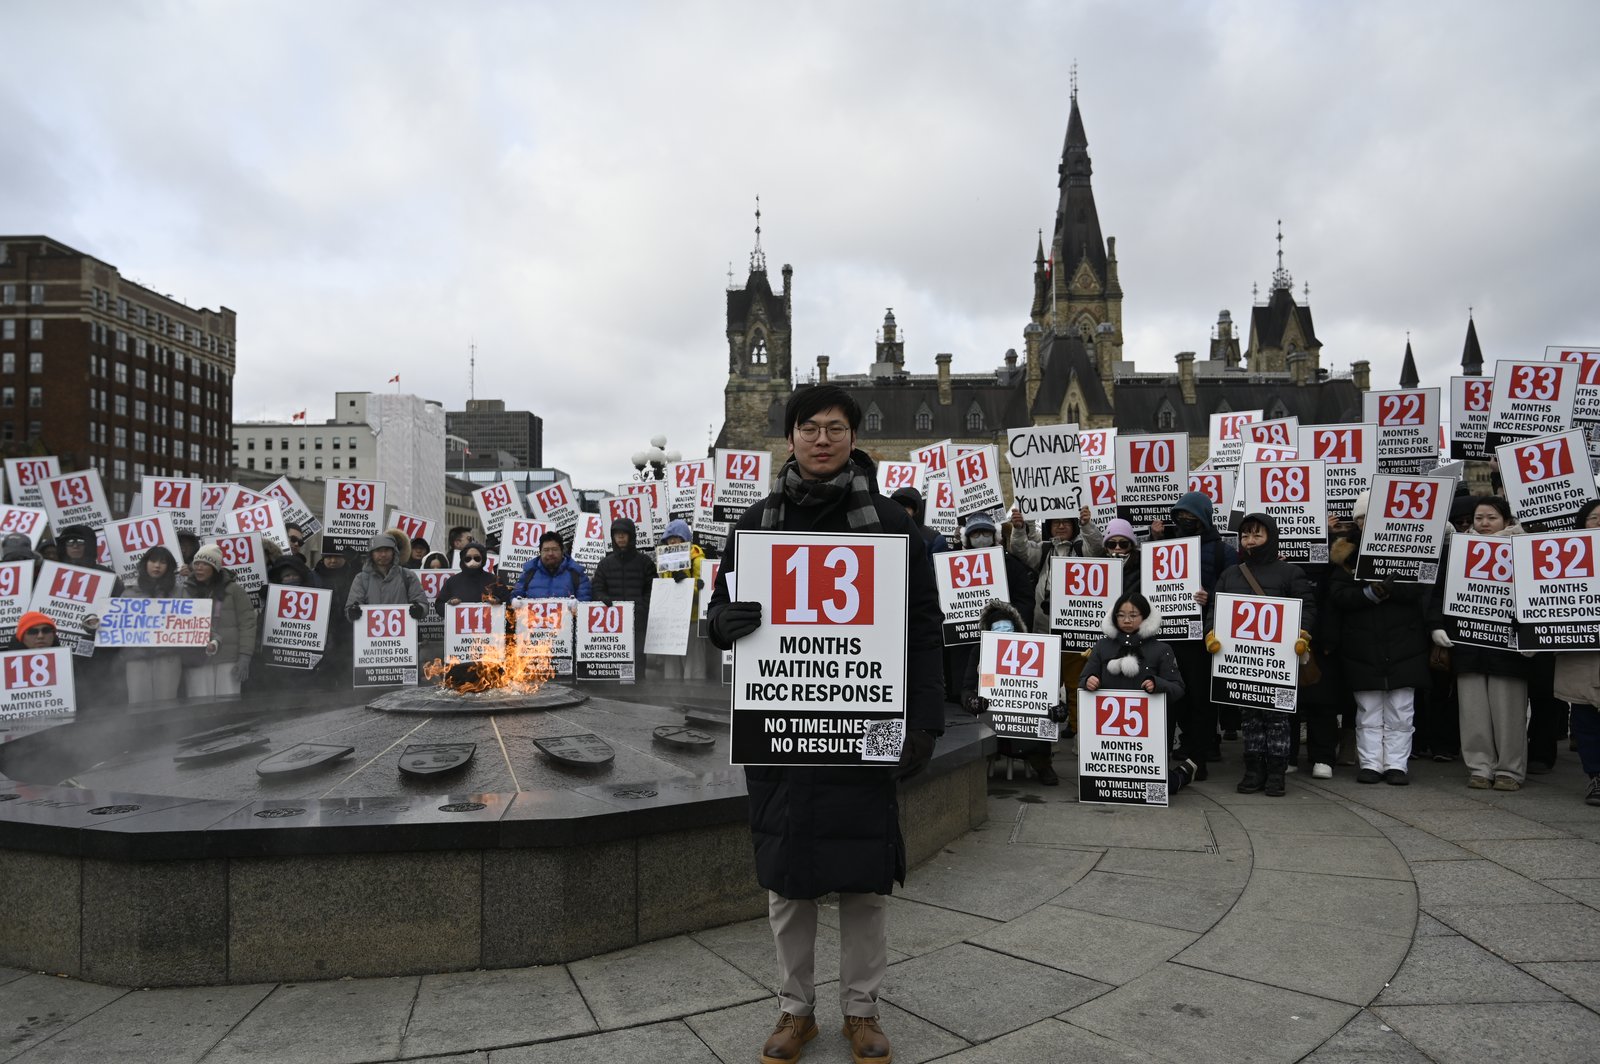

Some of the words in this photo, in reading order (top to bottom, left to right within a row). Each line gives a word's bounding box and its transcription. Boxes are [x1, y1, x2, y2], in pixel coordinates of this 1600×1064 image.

[1515, 367, 1556, 399] 33
[1384, 395, 1420, 425] 22
[1500, 413, 1539, 421] WAITING
[1542, 414, 1560, 422] FOR
[1511, 404, 1551, 412] MONTHS
[1493, 422, 1514, 430] IRCC
[1515, 423, 1564, 432] RESPONSE
[1010, 434, 1081, 457] CANADA
[1080, 434, 1102, 456] 23
[1320, 431, 1356, 463] 21
[922, 448, 940, 472] 27
[1136, 441, 1169, 472] 70
[1523, 440, 1561, 480] 37
[20, 462, 47, 485] 30
[679, 463, 700, 487] 27
[730, 455, 756, 480] 42
[888, 466, 914, 487] 32
[961, 455, 983, 485] 13
[1012, 467, 1051, 489] WHAT
[1053, 466, 1080, 485] ARE
[1134, 475, 1169, 483] MONTHS
[1266, 468, 1304, 502] 68
[59, 478, 88, 505] 43
[158, 482, 186, 507] 27
[342, 484, 370, 510] 39
[1126, 485, 1161, 494] WAITING
[1163, 484, 1179, 492] FOR
[1528, 480, 1570, 495] MONTHS
[202, 487, 226, 510] 22
[485, 486, 508, 509] 39
[541, 488, 562, 511] 19
[1015, 495, 1038, 514] YOU
[1041, 487, 1082, 511] DOING?
[1121, 495, 1140, 503] IRCC
[1391, 482, 1431, 518] 53
[1520, 492, 1561, 507] WAITING
[1564, 488, 1584, 499] FOR
[241, 508, 268, 532] 39
[613, 499, 638, 522] 30
[1516, 508, 1538, 518] IRCC
[3, 511, 35, 533] 38
[403, 518, 422, 538] 17
[1386, 523, 1425, 532] MONTHS
[126, 520, 158, 550] 40
[516, 523, 542, 546] 30
[1374, 533, 1414, 542] WAITING
[1415, 535, 1434, 543] FOR
[222, 538, 250, 565] 39
[1367, 543, 1388, 552] IRCC
[1388, 545, 1437, 554] RESPONSE
[1539, 538, 1587, 578] 32
[954, 554, 988, 587] 34
[1156, 545, 1184, 579] 30
[1470, 542, 1512, 581] 28
[56, 571, 91, 601] 11
[786, 547, 859, 622] 13
[1070, 564, 1104, 596] 30
[1468, 583, 1510, 595] MONTHS
[1540, 583, 1588, 594] MONTHS
[957, 589, 990, 600] MONTHS
[1069, 600, 1102, 608] MONTHS
[1457, 592, 1497, 605] WAITING
[1500, 598, 1513, 607] FO
[1528, 596, 1576, 606] WAITING
[1579, 594, 1600, 604] FOR
[109, 599, 151, 614] STOP
[157, 600, 193, 614] THE
[283, 592, 313, 619] 39
[1449, 603, 1470, 614] IRCC
[1472, 606, 1515, 619] RESPON
[1523, 609, 1546, 618] IRCC
[1549, 607, 1600, 618] RESPONS
[371, 610, 401, 636] 36
[460, 608, 486, 633] 11
[530, 604, 560, 628] 35
[591, 607, 619, 632] 20
[1236, 602, 1277, 641] 20
[1457, 620, 1468, 628] NO
[273, 629, 302, 638] WAITING
[281, 622, 311, 630] MONTHS
[1534, 626, 1547, 634] NO
[1549, 624, 1598, 633] TIMELINES
[284, 639, 321, 647] RESPONSE
[780, 637, 861, 655] MONTHS
[1460, 630, 1470, 638] NO
[1473, 631, 1508, 643] RESULTS
[1540, 636, 1552, 644] NO
[1555, 635, 1595, 643] RESULTS
[1001, 641, 1038, 676] 42
[1236, 644, 1276, 656] MONTHS
[758, 660, 839, 678] WAITING
[845, 662, 882, 678] FOR
[1225, 654, 1265, 666] WAITING
[1268, 659, 1286, 668] FOR
[11, 654, 49, 688] 18
[1219, 665, 1240, 675] IRCC
[1241, 668, 1291, 680] RESPONSE
[746, 683, 788, 701] IRCC
[792, 685, 893, 702] RESPONSE
[1001, 680, 1038, 690] MONTHS
[1226, 682, 1237, 690] NO
[1239, 683, 1276, 694] TIMELINE
[988, 699, 1004, 707] RCC
[991, 690, 1028, 700] WAITING
[1031, 692, 1048, 700] FOR
[1229, 691, 1240, 699] NO
[765, 718, 786, 732] NO
[1101, 697, 1142, 735] 25
[771, 738, 793, 752] NO
[798, 739, 863, 753] RESULTS
[1102, 741, 1144, 751] MONTHS
[1092, 752, 1133, 762] WAITING
[1136, 754, 1155, 763] FOR
[1086, 763, 1108, 772] IRCC
[1109, 765, 1161, 775] RESPONSE
[1099, 789, 1110, 797] NO
[1108, 780, 1146, 790] TIMELINE
